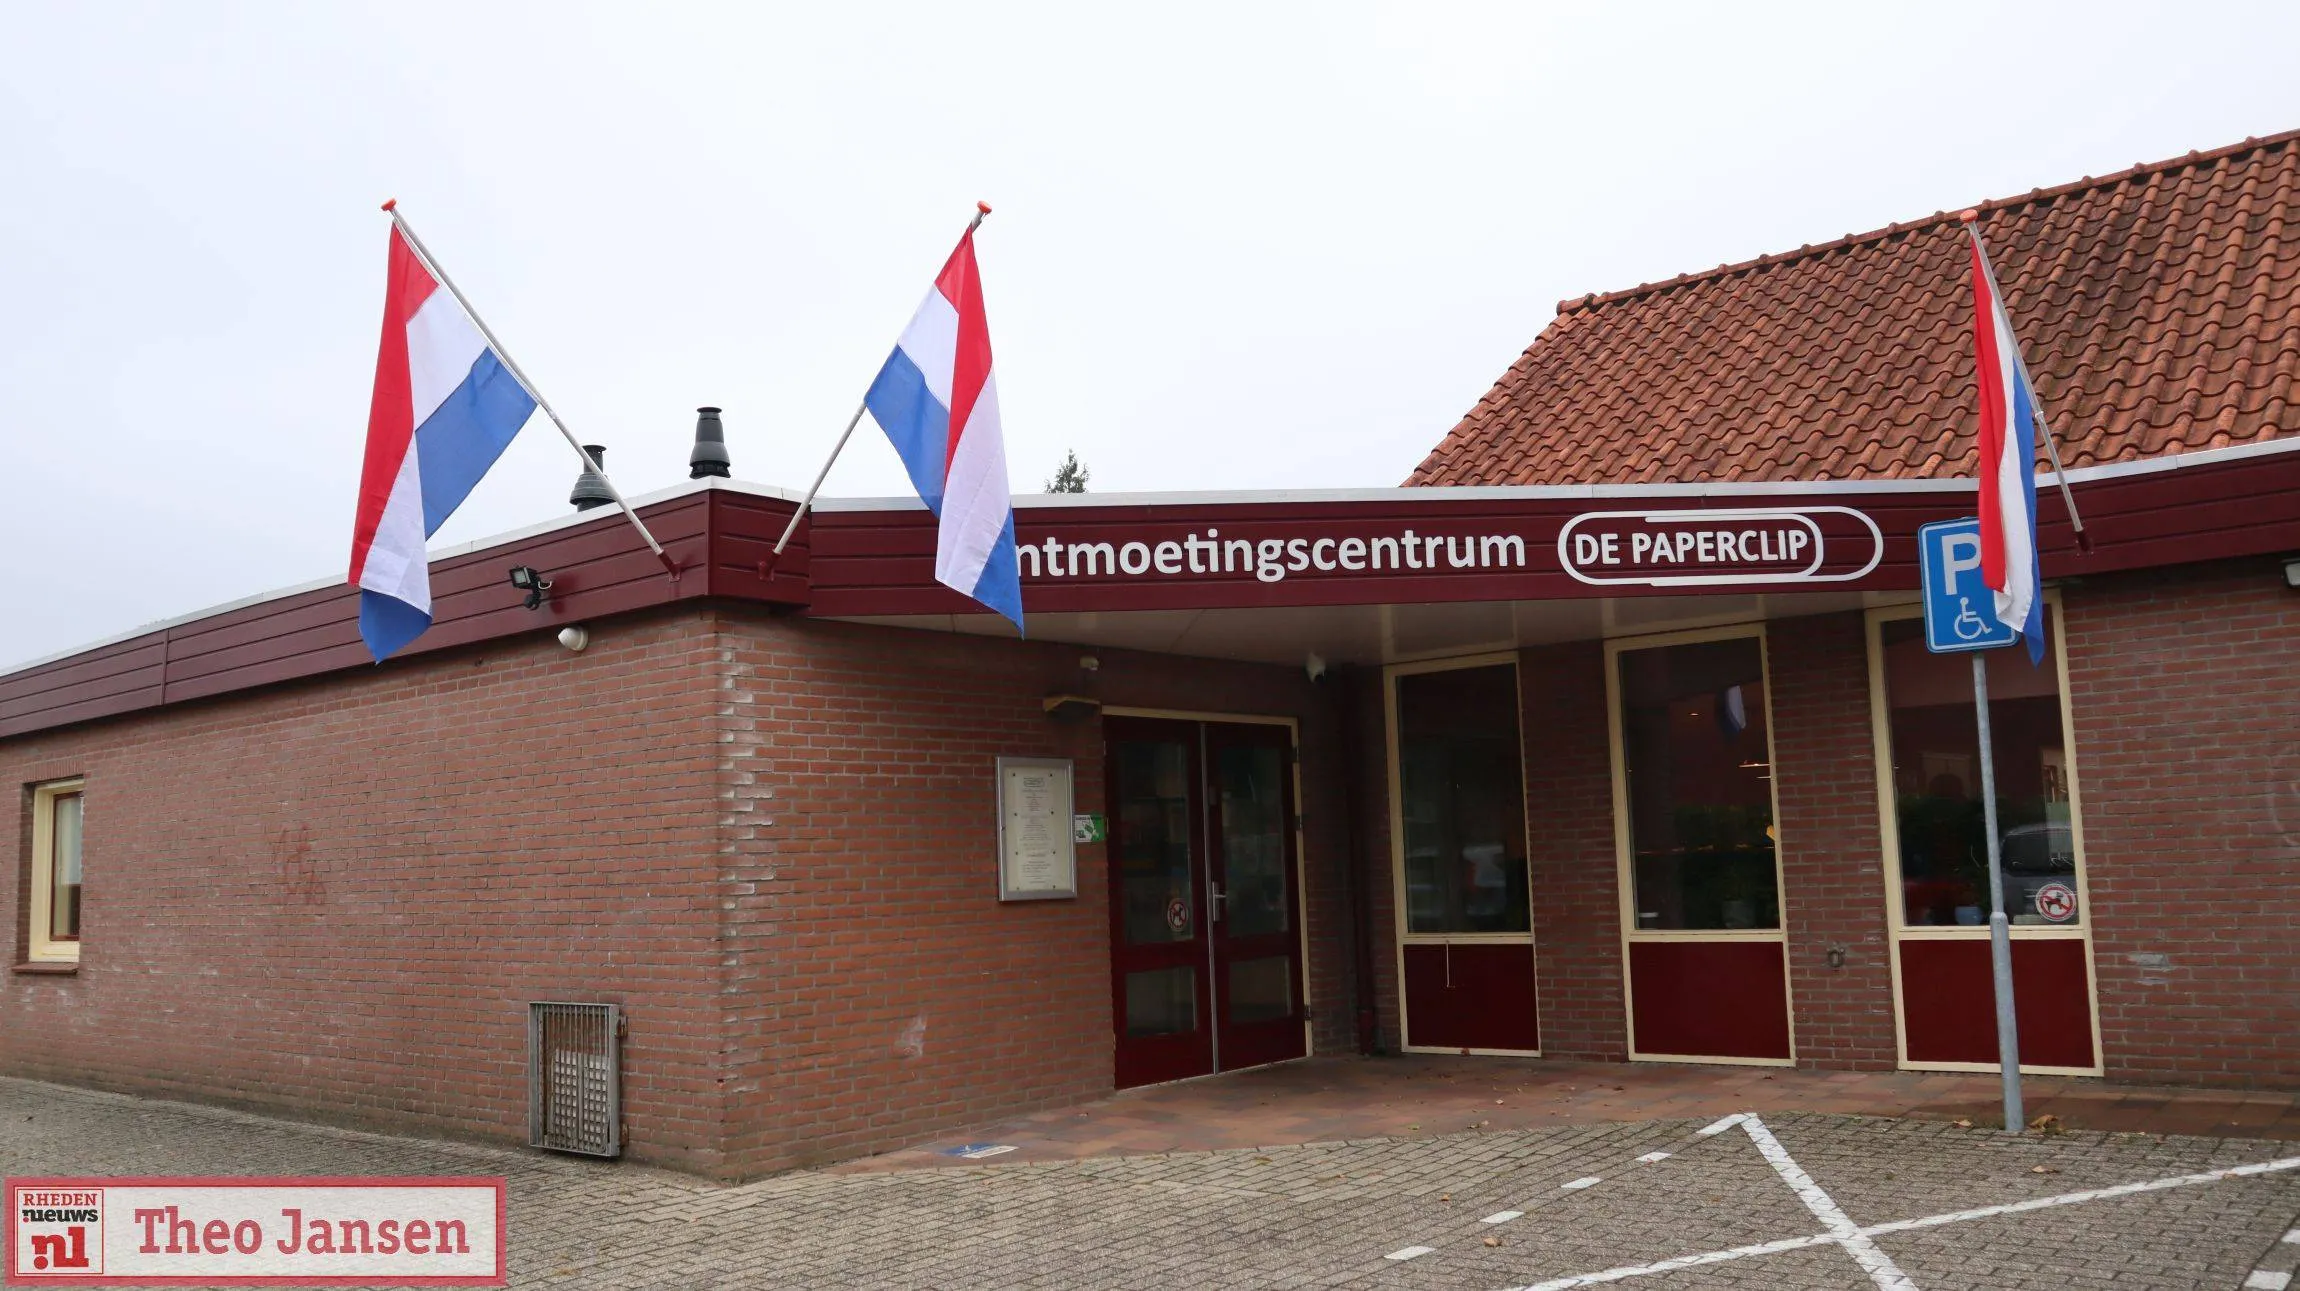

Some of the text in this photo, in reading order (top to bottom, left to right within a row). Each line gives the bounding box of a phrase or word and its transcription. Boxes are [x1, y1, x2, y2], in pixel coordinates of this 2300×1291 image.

[1575, 533, 1621, 565] DE
[1631, 529, 1808, 564] PAPERCLIP
[1941, 532, 1982, 596] P
